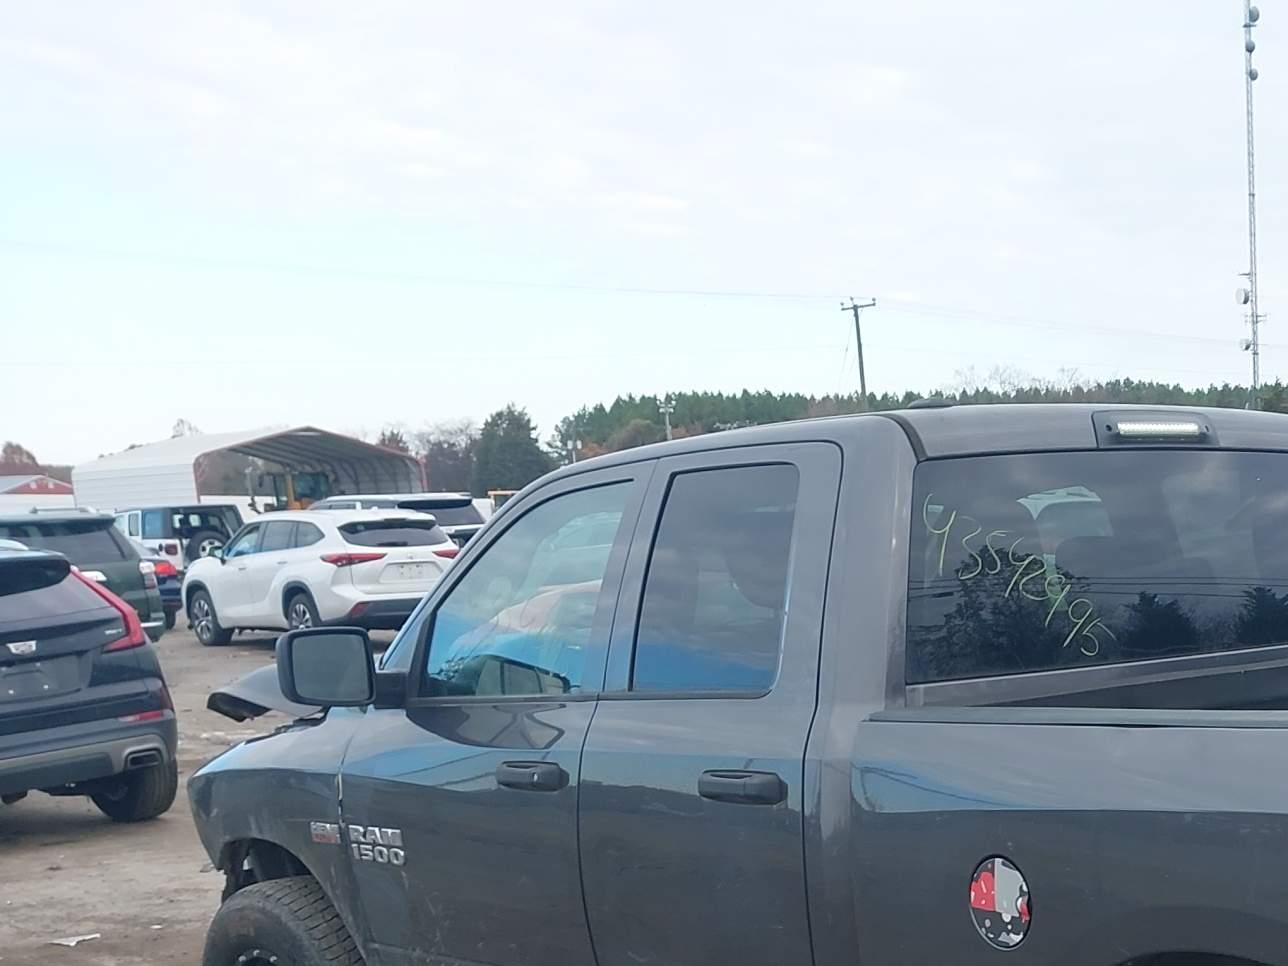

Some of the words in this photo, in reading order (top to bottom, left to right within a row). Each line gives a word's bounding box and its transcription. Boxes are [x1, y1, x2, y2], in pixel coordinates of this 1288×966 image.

[921, 493, 1117, 657] 43542995
[349, 825, 402, 846] RAM
[351, 844, 404, 865] 1500
